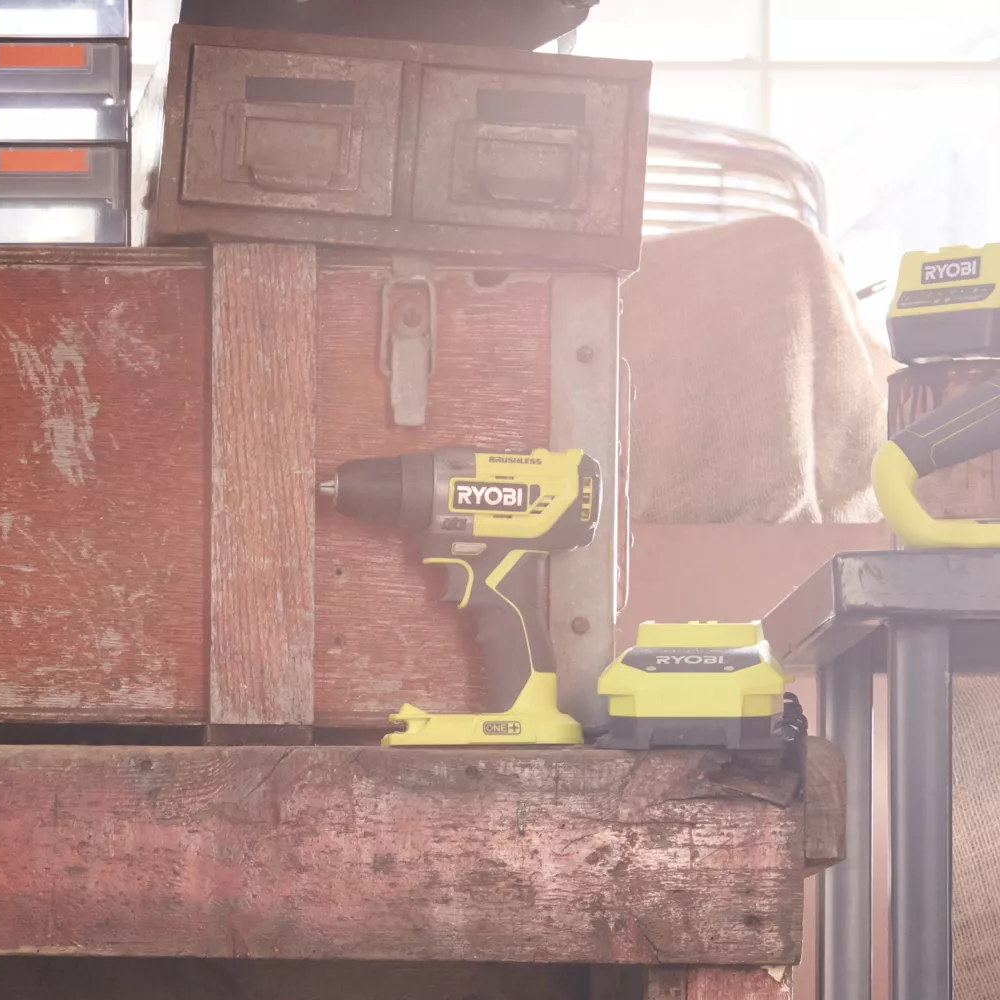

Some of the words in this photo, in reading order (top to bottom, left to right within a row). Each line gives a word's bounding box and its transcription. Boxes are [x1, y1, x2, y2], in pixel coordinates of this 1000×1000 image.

[924, 260, 977, 280] RYOBI
[488, 456, 542, 465] BRUSHLESS
[456, 485, 523, 506] RYOBI
[655, 655, 724, 665] RYOBI
